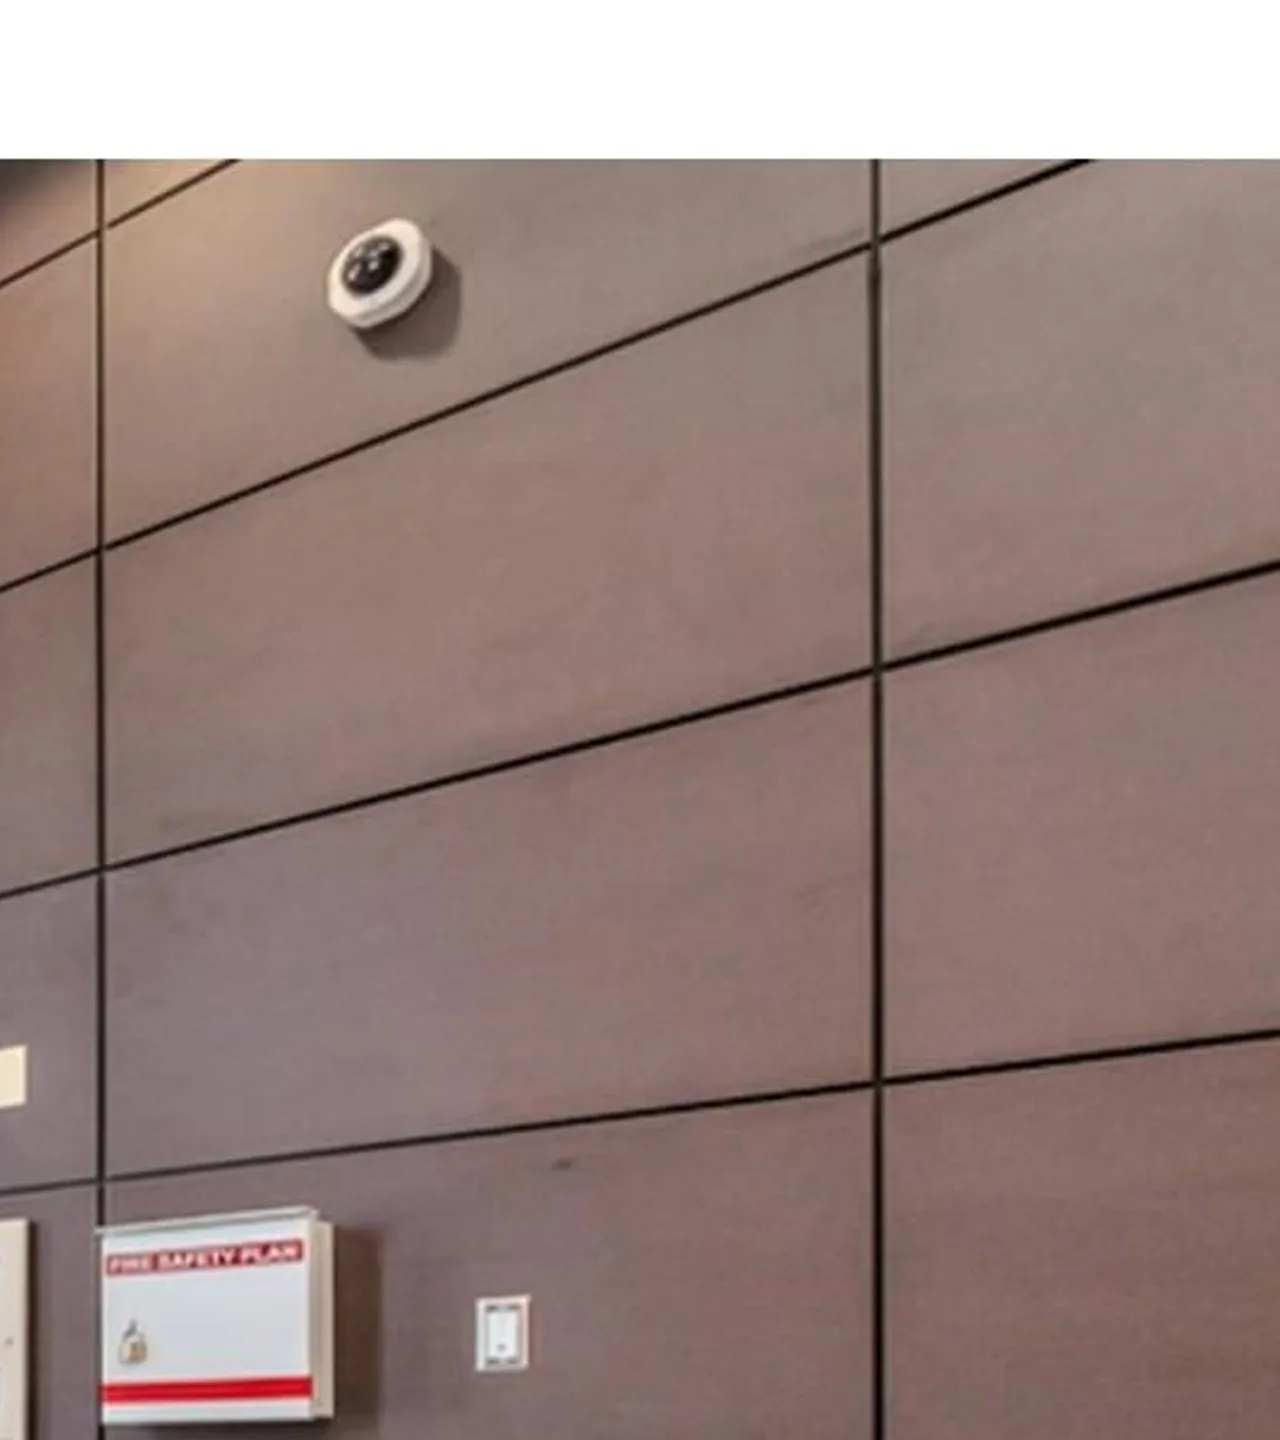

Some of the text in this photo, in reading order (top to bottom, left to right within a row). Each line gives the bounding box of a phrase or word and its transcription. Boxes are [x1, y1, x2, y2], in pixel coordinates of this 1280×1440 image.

[109, 1243, 303, 1276] FIRE SAFETY PLAN
